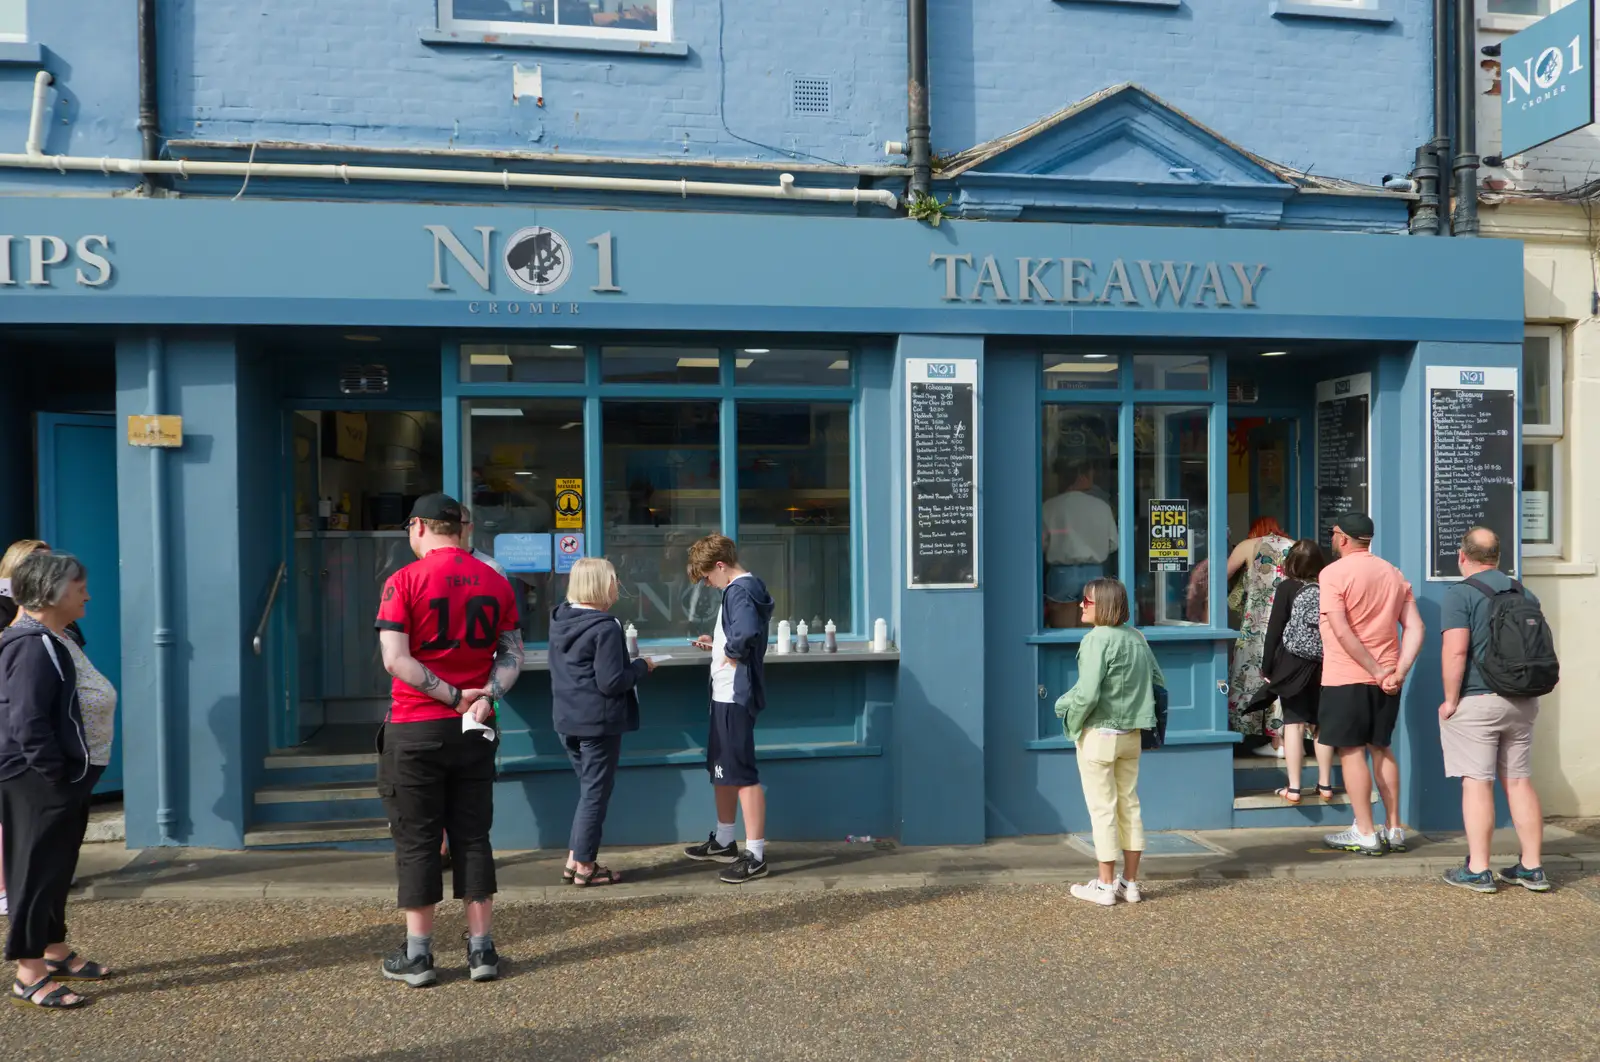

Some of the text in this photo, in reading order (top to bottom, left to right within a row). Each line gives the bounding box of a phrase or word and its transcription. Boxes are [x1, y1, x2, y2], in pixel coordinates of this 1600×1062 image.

[1521, 85, 1566, 110] CROMER
[930, 251, 1266, 306] TAKEAWAY
[468, 302, 581, 314] CROMER
[1455, 390, 1485, 402] Takeaway
[1151, 504, 1186, 512] NATIONAL
[1151, 511, 1187, 526] FISH
[1151, 525, 1187, 539] CHIP
[1151, 541, 1172, 549] 2025
[446, 575, 481, 588] TENZ
[420, 595, 501, 651] 10
